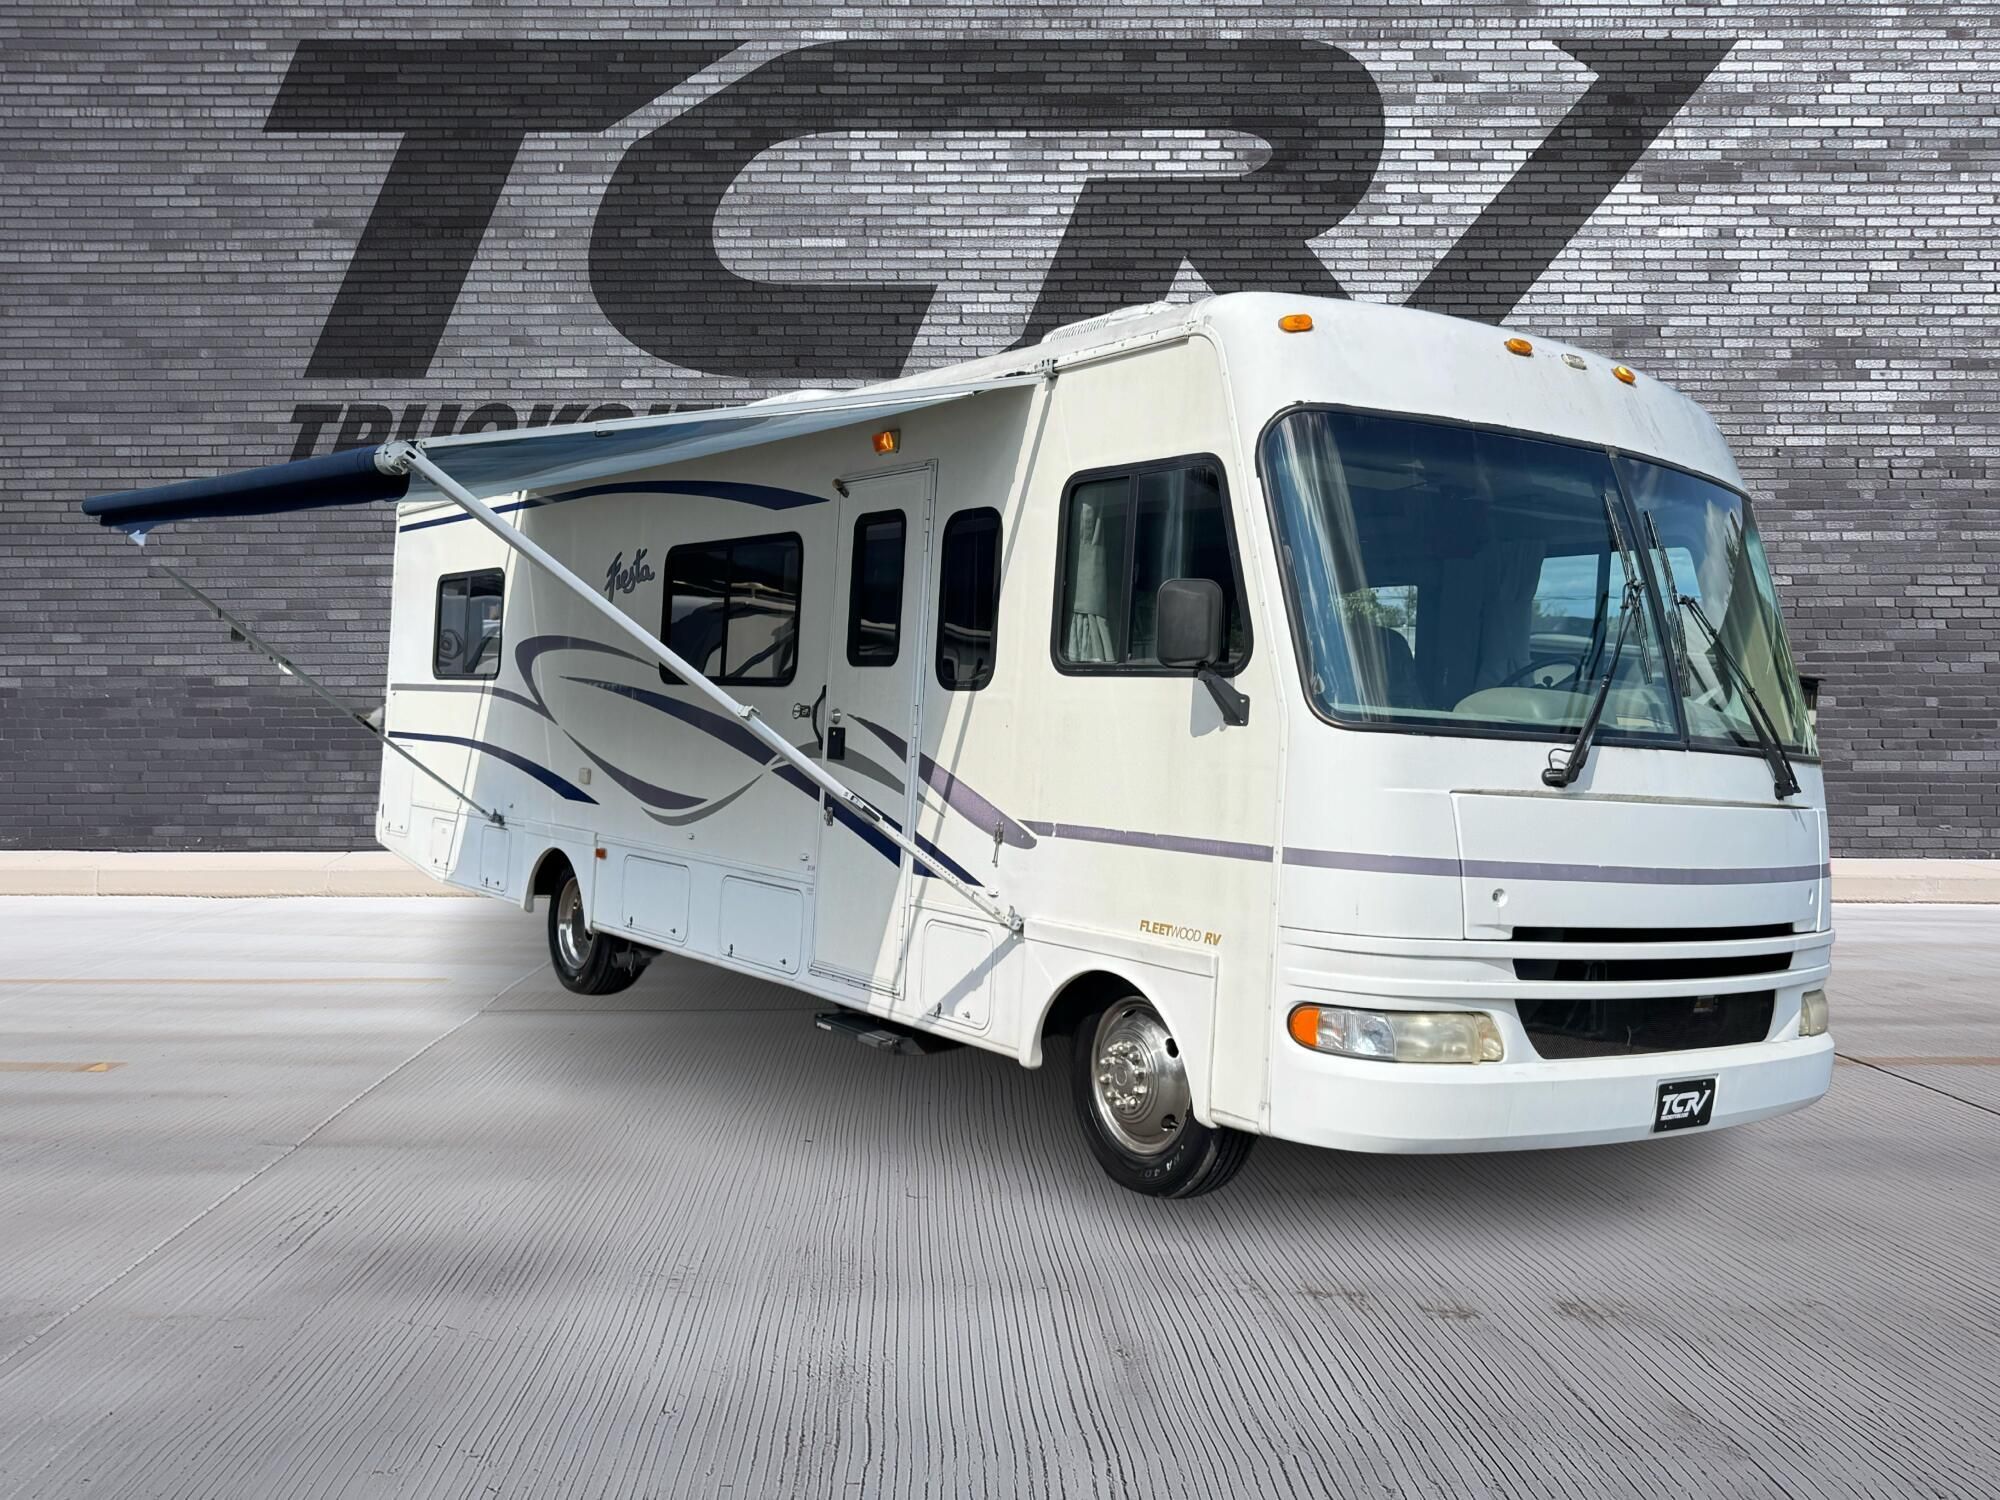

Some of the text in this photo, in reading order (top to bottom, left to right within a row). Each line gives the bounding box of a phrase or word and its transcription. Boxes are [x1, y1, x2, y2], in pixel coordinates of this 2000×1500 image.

[604, 548, 655, 603] Fiesta
[1139, 919, 1222, 946] FLEETWOOD RV
[1661, 1089, 1712, 1116] TCRV
